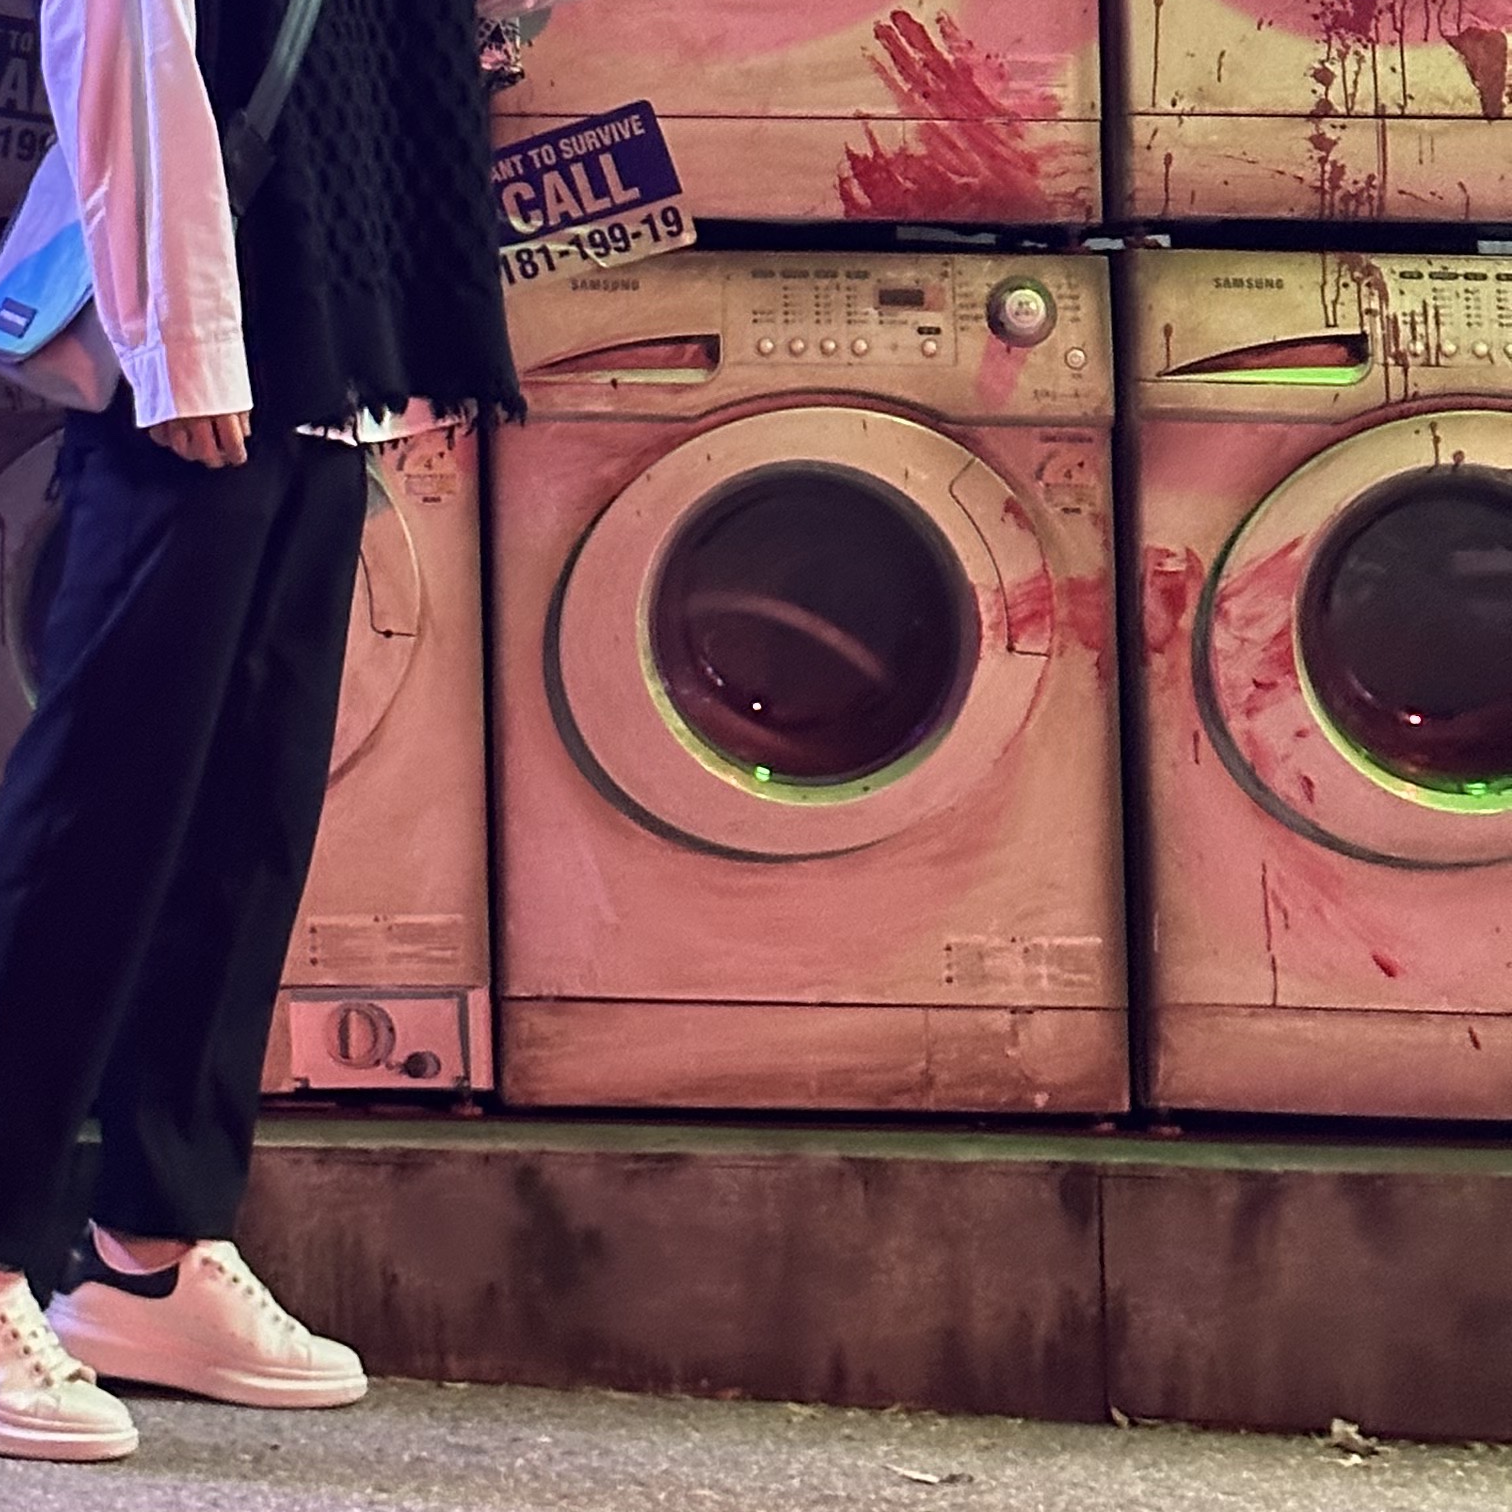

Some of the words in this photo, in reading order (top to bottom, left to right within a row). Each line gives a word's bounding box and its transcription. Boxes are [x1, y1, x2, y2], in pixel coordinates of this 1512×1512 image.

[8, 30, 35, 52] TO
[491, 155, 524, 183] ANT
[527, 143, 557, 169] TO
[558, 115, 646, 160] SURVIVE
[501, 152, 641, 235] CALL
[501, 205, 684, 286] 181-199-19
[1213, 277, 1284, 290] SAMSUNG
